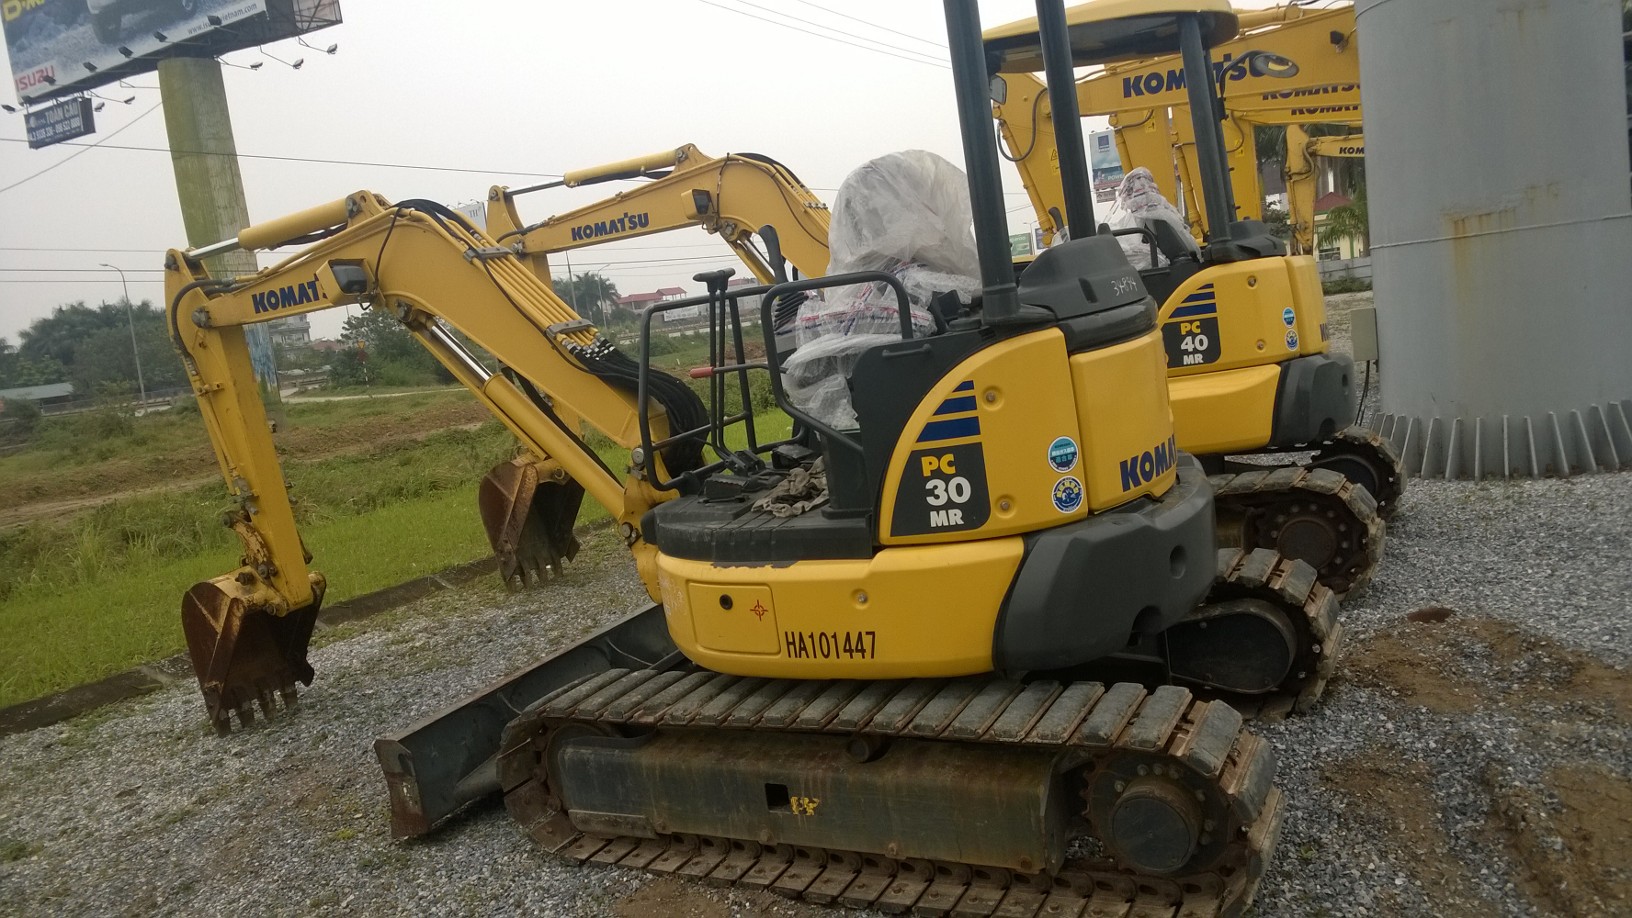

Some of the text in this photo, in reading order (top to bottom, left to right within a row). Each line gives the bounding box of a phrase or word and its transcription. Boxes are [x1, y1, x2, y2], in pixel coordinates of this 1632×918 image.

[571, 212, 650, 241] KOMATSU
[251, 273, 328, 315] KOMAT
[1180, 321, 1201, 335] PC
[1180, 334, 1209, 352] 40
[1183, 353, 1204, 365] MR
[920, 453, 956, 477] PC
[925, 476, 972, 506] 30
[930, 509, 964, 528] MR
[784, 631, 876, 659] HA101447
